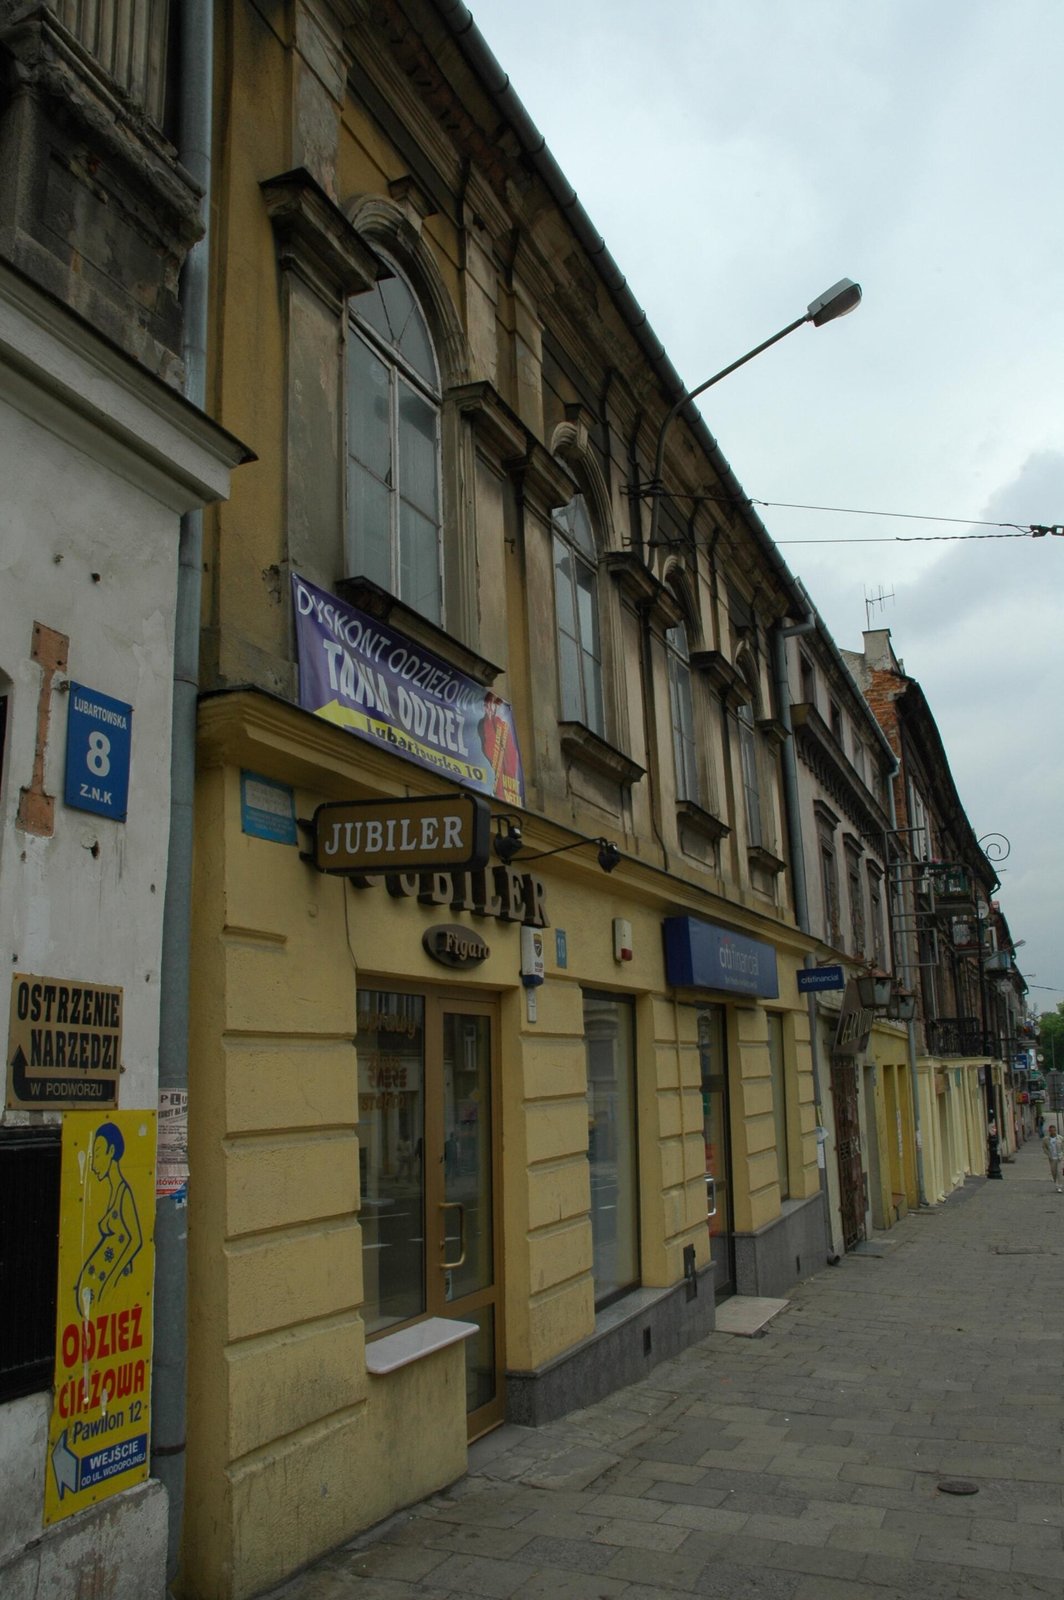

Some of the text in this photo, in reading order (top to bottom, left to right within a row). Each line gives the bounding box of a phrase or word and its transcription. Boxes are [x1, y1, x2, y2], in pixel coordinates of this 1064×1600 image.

[297, 585, 391, 662] DYSKONT
[74, 696, 127, 730] LUBARTOWSKA
[323, 639, 397, 720] TANIA
[397, 685, 469, 757] ODZIEŻ
[86, 731, 111, 777] 8
[366, 718, 462, 775] Lubartowska
[465, 765, 483, 781] 10
[80, 783, 112, 805] Z.N.K
[324, 815, 464, 855] JUBILER
[358, 863, 550, 928] UBILER
[445, 931, 491, 961] Figaro
[801, 973, 840, 985] citifinancial
[17, 981, 120, 1029] OSTRZENIE
[30, 1028, 119, 1075] NARZĘDZI
[30, 1081, 103, 1097] W PODWÓRZU
[62, 1304, 143, 1368] ODZIEŻ
[59, 1359, 145, 1419] CIĄŻOWA
[73, 1400, 142, 1444] Pawilon 12
[81, 1475, 92, 1487] OD
[103, 1452, 146, 1477] WODOPOJNEJ
[90, 1440, 138, 1470] WEJŚCIE
